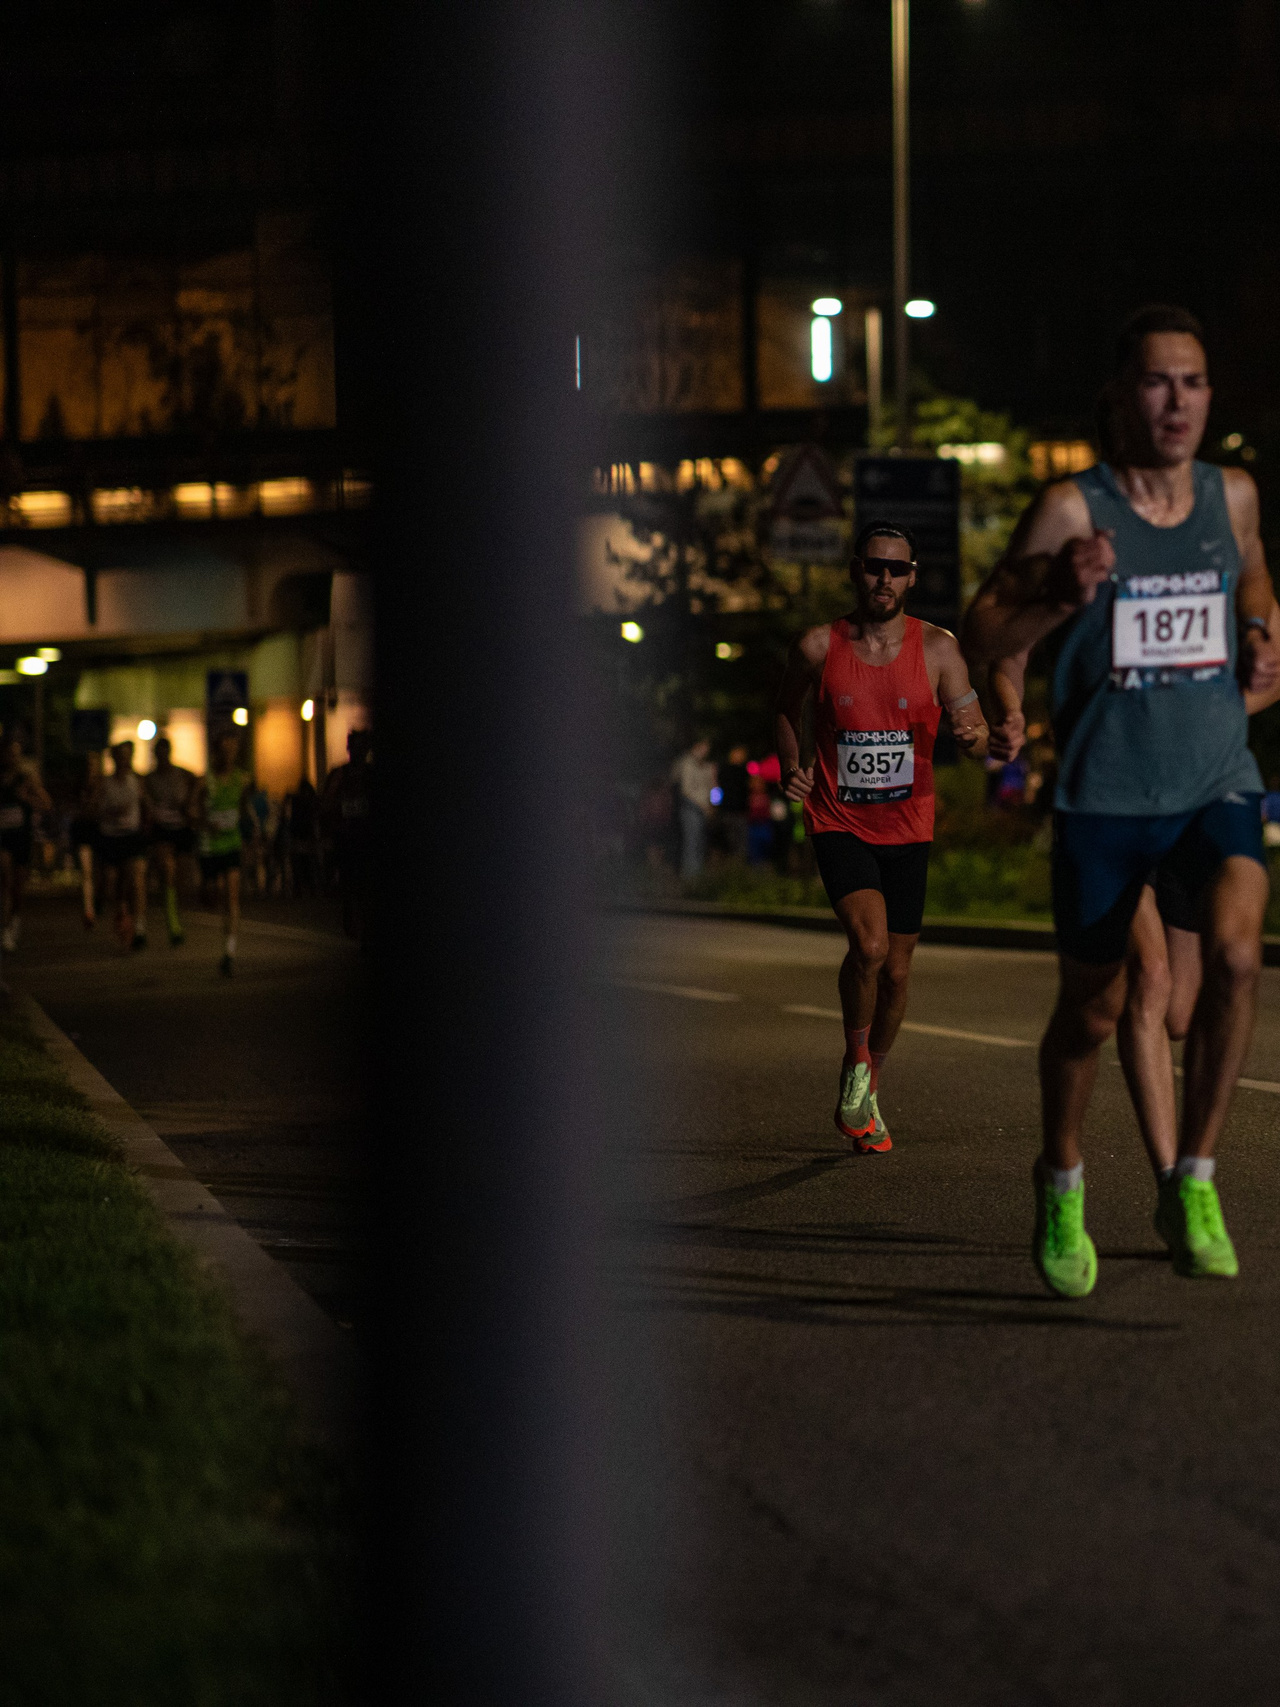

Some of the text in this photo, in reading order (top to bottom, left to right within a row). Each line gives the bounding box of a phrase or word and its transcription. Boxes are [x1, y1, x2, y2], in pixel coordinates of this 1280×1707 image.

[1135, 606, 1209, 643] 1871
[847, 752, 905, 774] 6357
[860, 776, 891, 785] АНДРЕЙ
